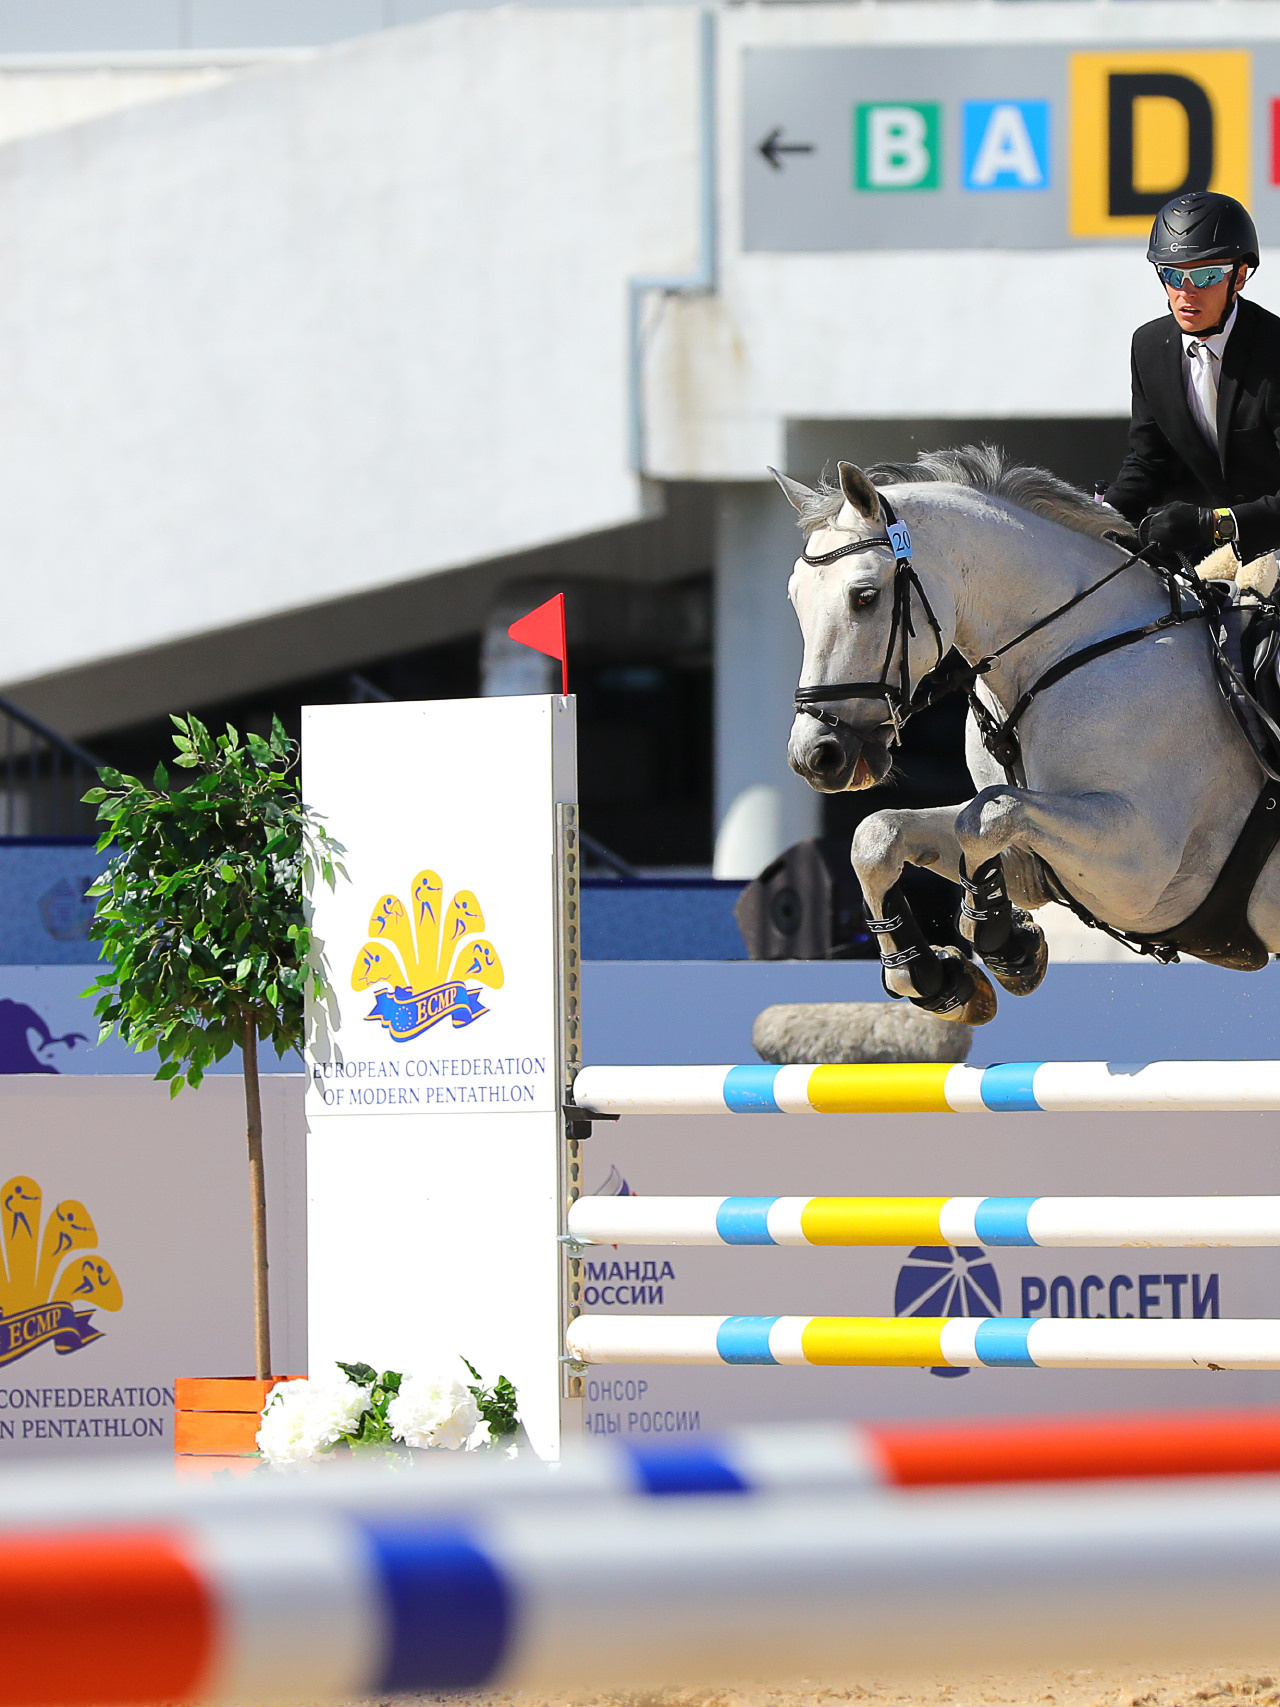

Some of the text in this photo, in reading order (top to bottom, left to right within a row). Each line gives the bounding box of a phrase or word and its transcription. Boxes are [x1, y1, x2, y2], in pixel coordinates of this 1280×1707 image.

[867, 105, 931, 186] B
[971, 105, 1043, 185] A
[1107, 71, 1215, 217] D
[892, 530, 911, 552] 20
[415, 986, 459, 1025] ECMP
[313, 1057, 546, 1079] EUROPEAN CONFEDERATION
[324, 1085, 535, 1106] OF MODERN PENTATHLON
[583, 1261, 676, 1283] МАНДА
[584, 1286, 664, 1306] ОССИИ
[1021, 1273, 1220, 1319] РОССЕТИ
[8, 1308, 62, 1350] ECMP
[588, 1380, 649, 1401] ОНСОР
[22, 1418, 164, 1438] PENTATHLON
[628, 1411, 701, 1433] РОССИИ
